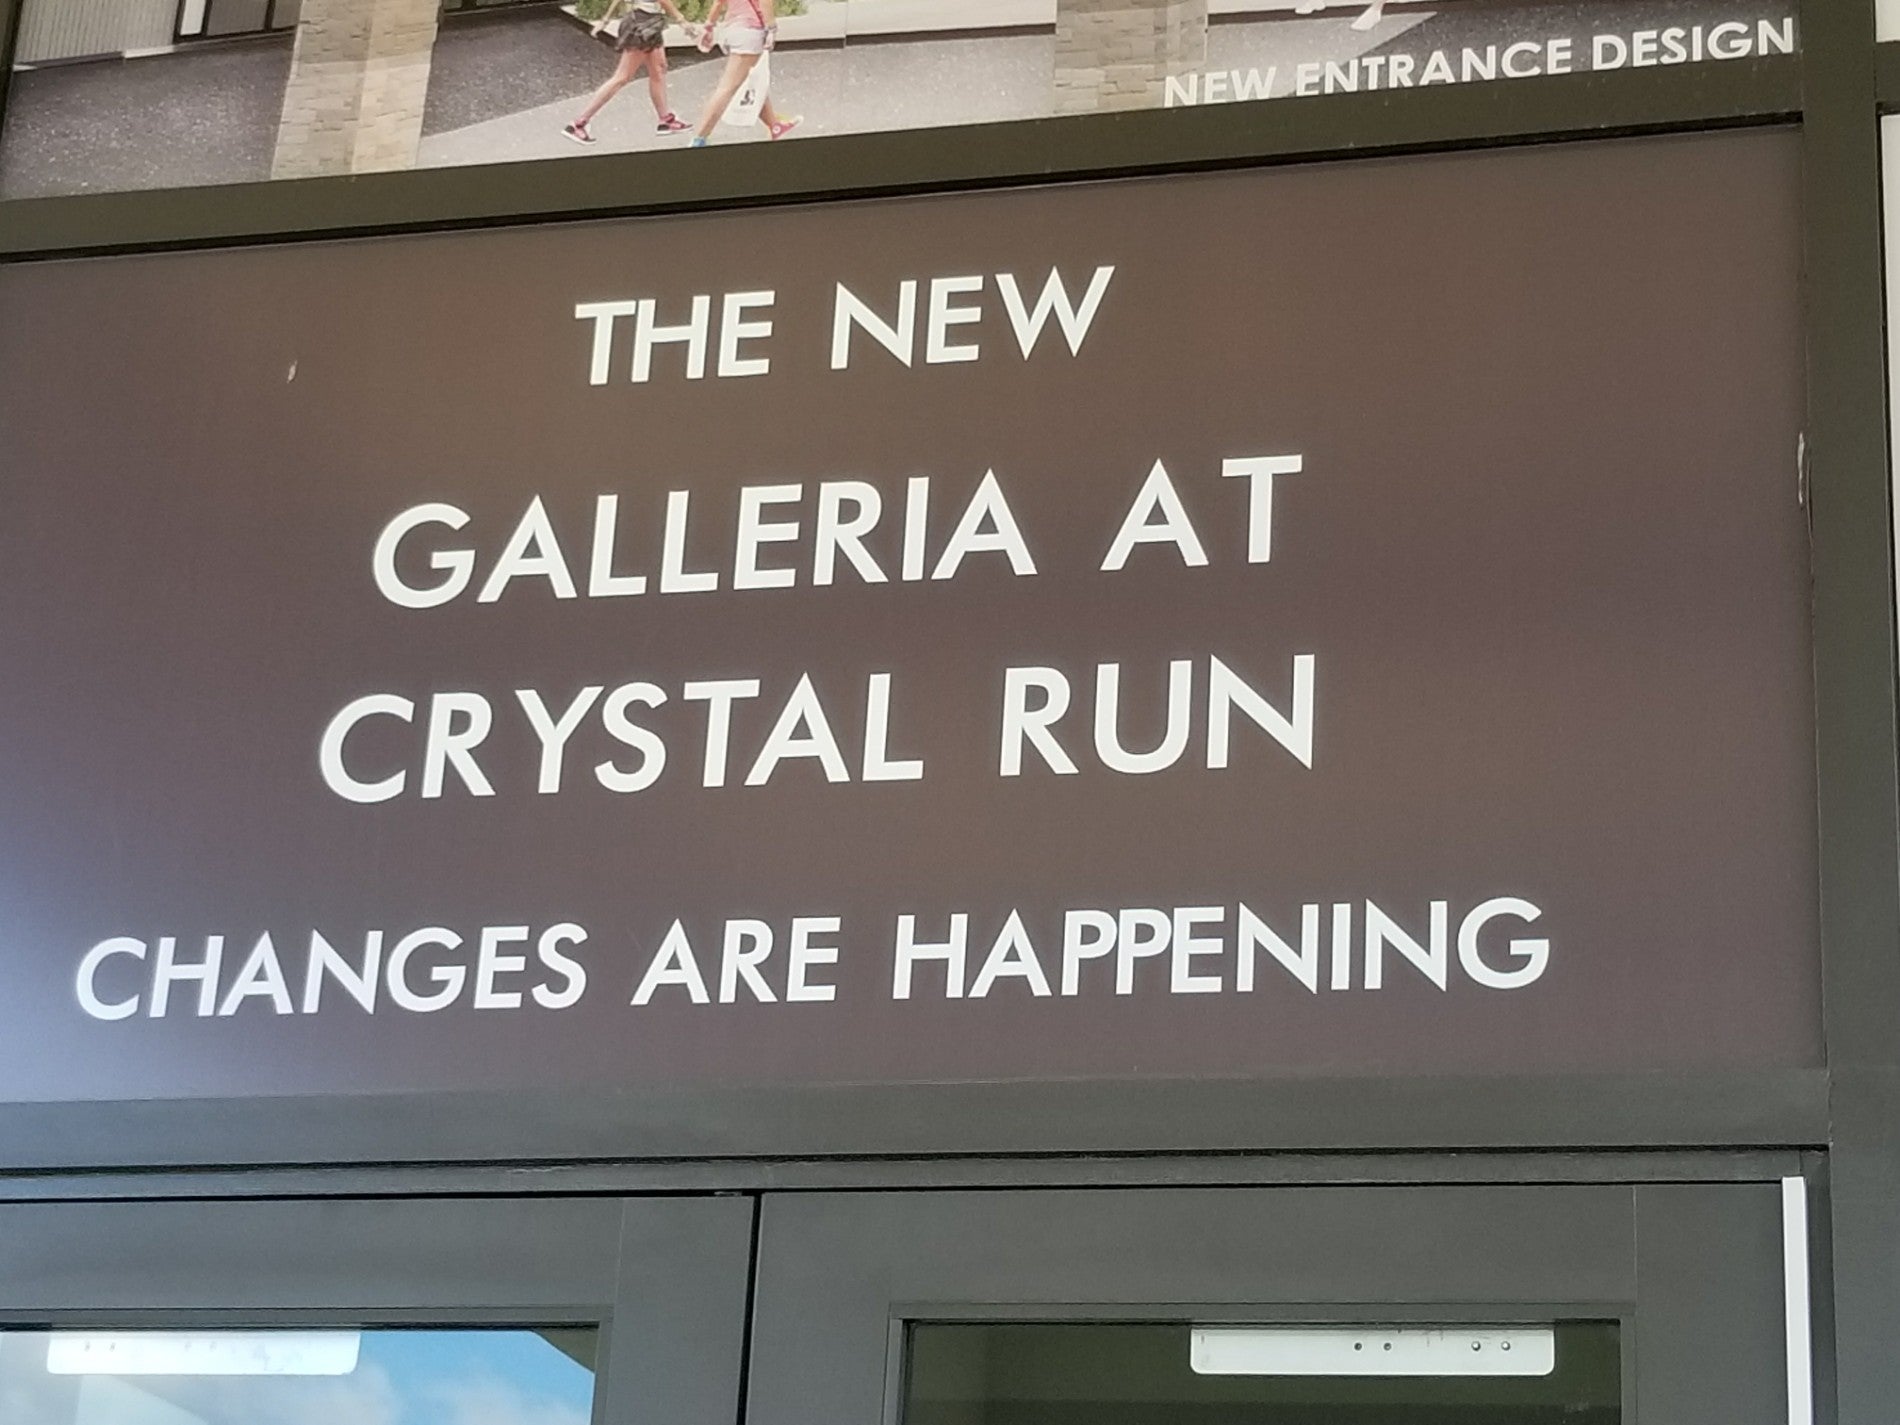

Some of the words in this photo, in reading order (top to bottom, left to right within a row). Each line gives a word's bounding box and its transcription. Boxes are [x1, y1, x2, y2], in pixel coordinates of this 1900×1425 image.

[1164, 66, 1277, 108] NEW
[1295, 38, 1572, 97] ENTRANCE
[1592, 17, 1794, 71] DESIGN
[574, 288, 776, 386] THE
[830, 265, 1115, 370] NEW
[372, 468, 1038, 609] GALLERIA
[1100, 454, 1303, 571] AT
[318, 672, 924, 804] CRYSTAL
[999, 654, 1316, 777] RUN
[74, 922, 588, 1021] CHANGES
[630, 915, 841, 1006] ARE
[892, 897, 1551, 1000] HAPPENING
